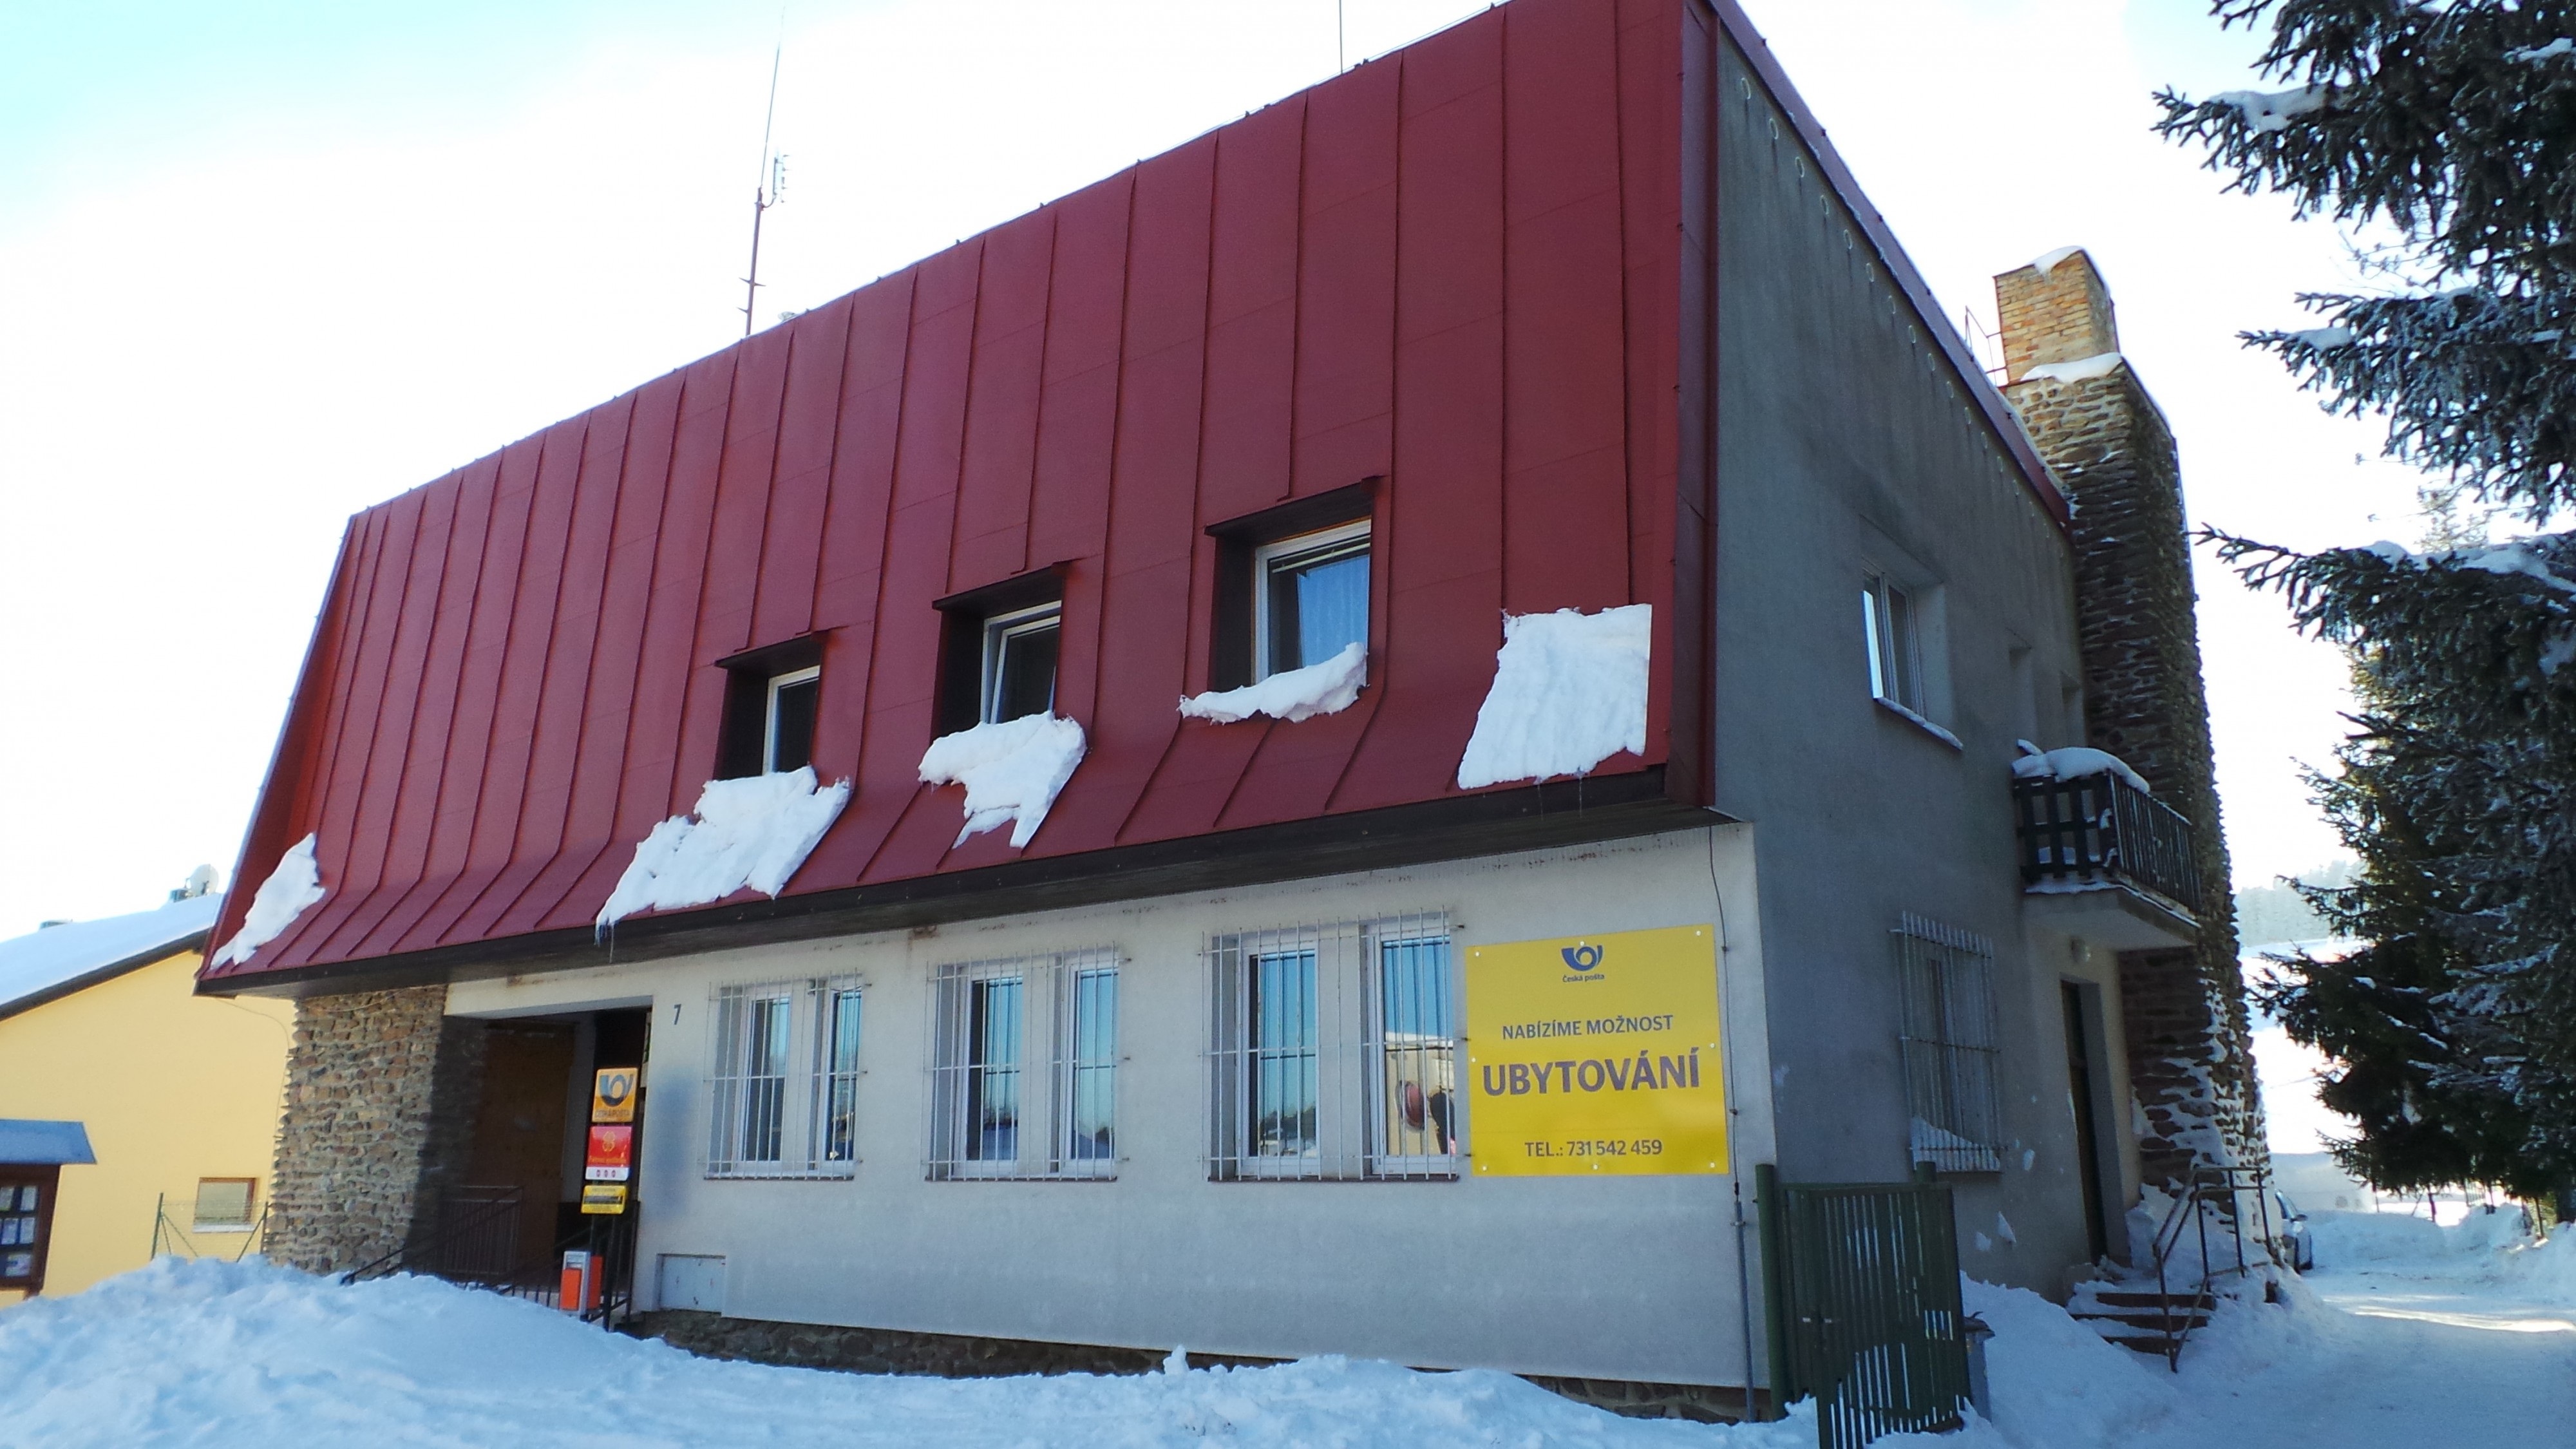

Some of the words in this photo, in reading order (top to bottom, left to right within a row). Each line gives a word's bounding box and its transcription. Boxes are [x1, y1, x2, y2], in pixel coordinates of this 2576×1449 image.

[1562, 974, 1583, 983] Česká
[1584, 974, 1605, 982] pošta
[674, 1003, 681, 1025] 7
[1502, 1019, 1582, 1039] NABÍZÍME
[1587, 1015, 1673, 1034] MOŽNOST
[1483, 1046, 1699, 1096] UBYTOVÁNÍ
[1524, 1142, 1563, 1157] TEL.:
[1566, 1141, 1591, 1156] 731
[1596, 1140, 1626, 1155] 542
[1631, 1139, 1662, 1155] 459
